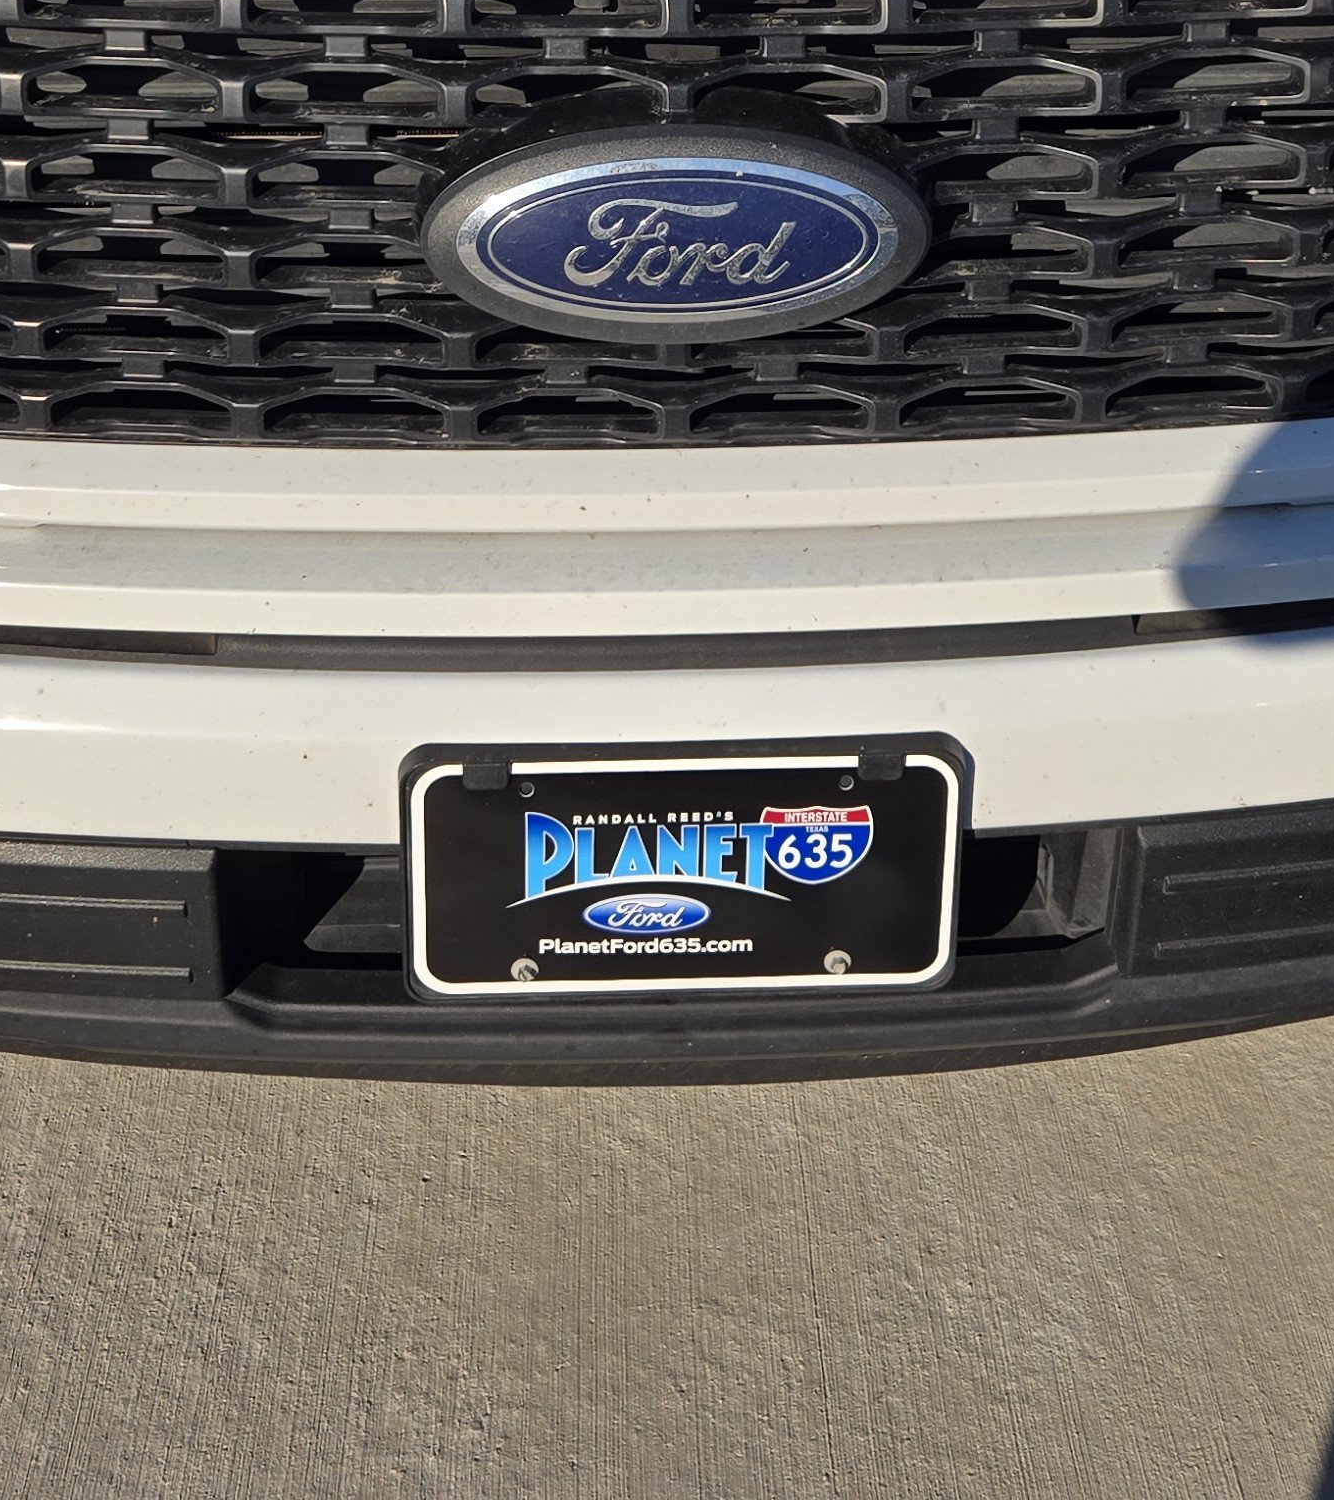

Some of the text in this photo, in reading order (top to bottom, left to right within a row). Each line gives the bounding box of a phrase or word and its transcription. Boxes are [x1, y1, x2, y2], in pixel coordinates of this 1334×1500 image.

[563, 197, 797, 287] Ford
[572, 811, 734, 825] RANDALL REED'S
[784, 812, 847, 823] INTERSTATE
[805, 825, 829, 833] TEXAS
[525, 812, 774, 900] PLANET
[778, 833, 853, 869] 635
[607, 900, 686, 928] Ford
[538, 937, 753, 954] PlanetFord635.com
